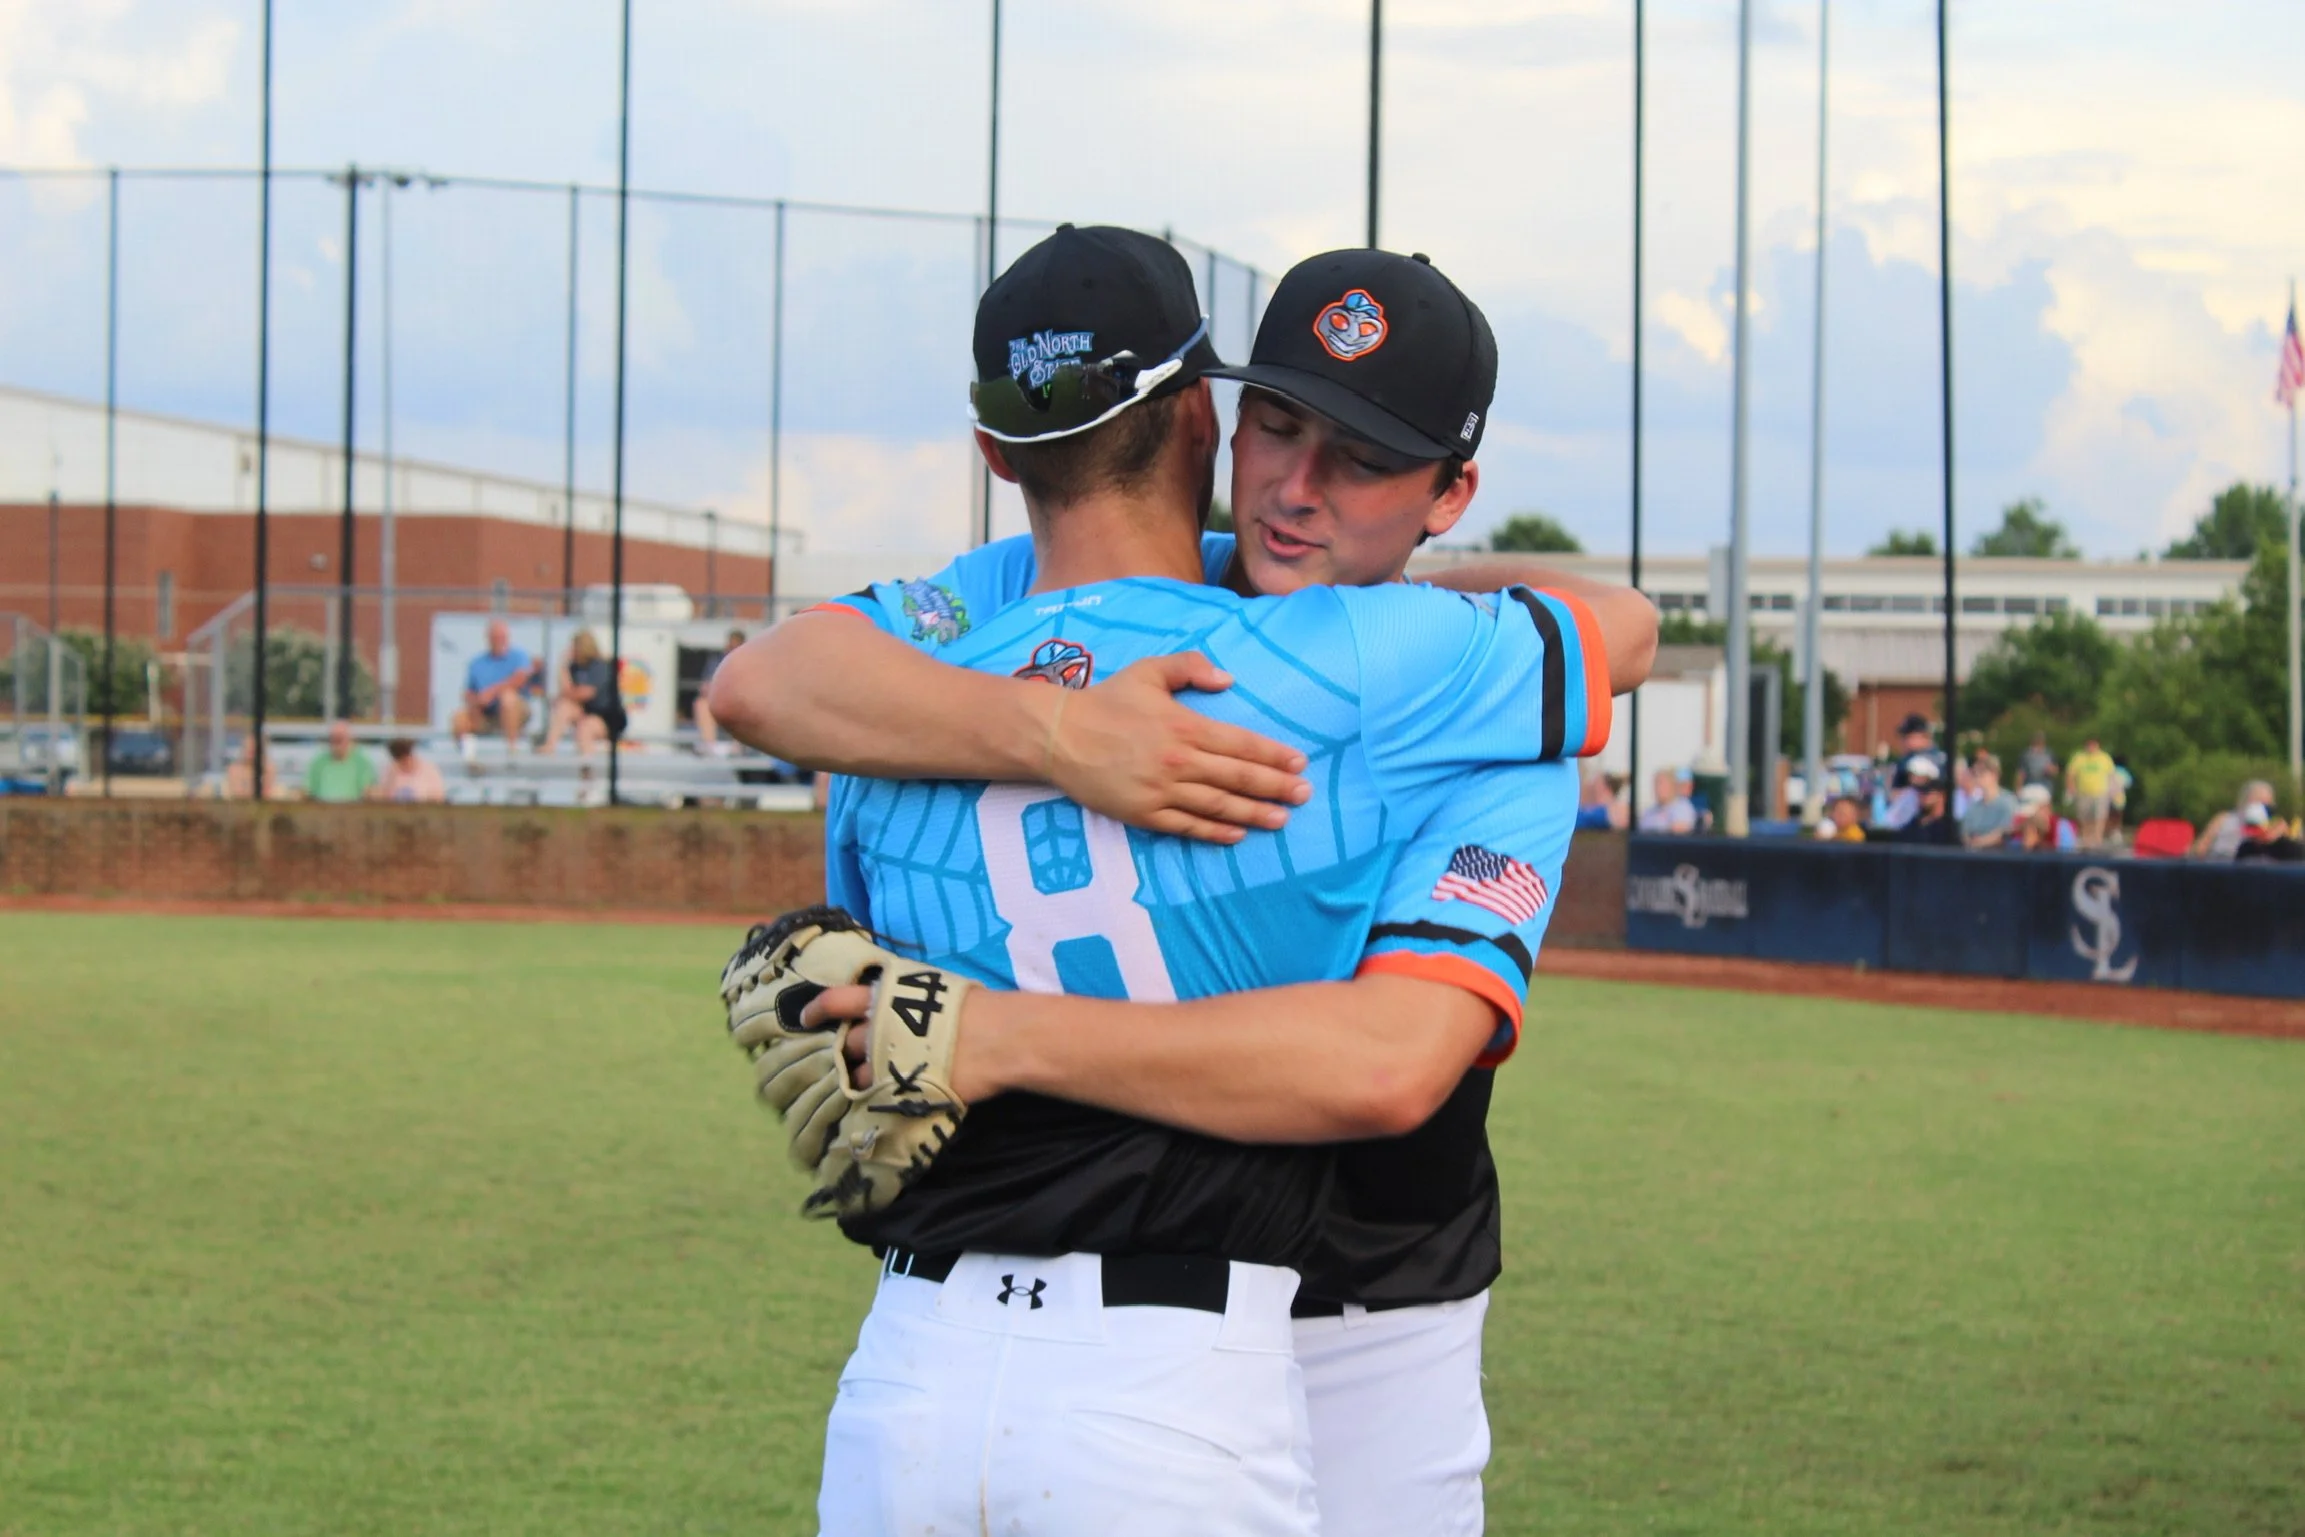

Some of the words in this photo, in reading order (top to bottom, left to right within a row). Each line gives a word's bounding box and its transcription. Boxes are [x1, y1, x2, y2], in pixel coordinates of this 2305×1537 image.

[1034, 330, 1091, 357] NORTH
[976, 781, 1178, 1003] 8
[891, 971, 948, 1037] 44
